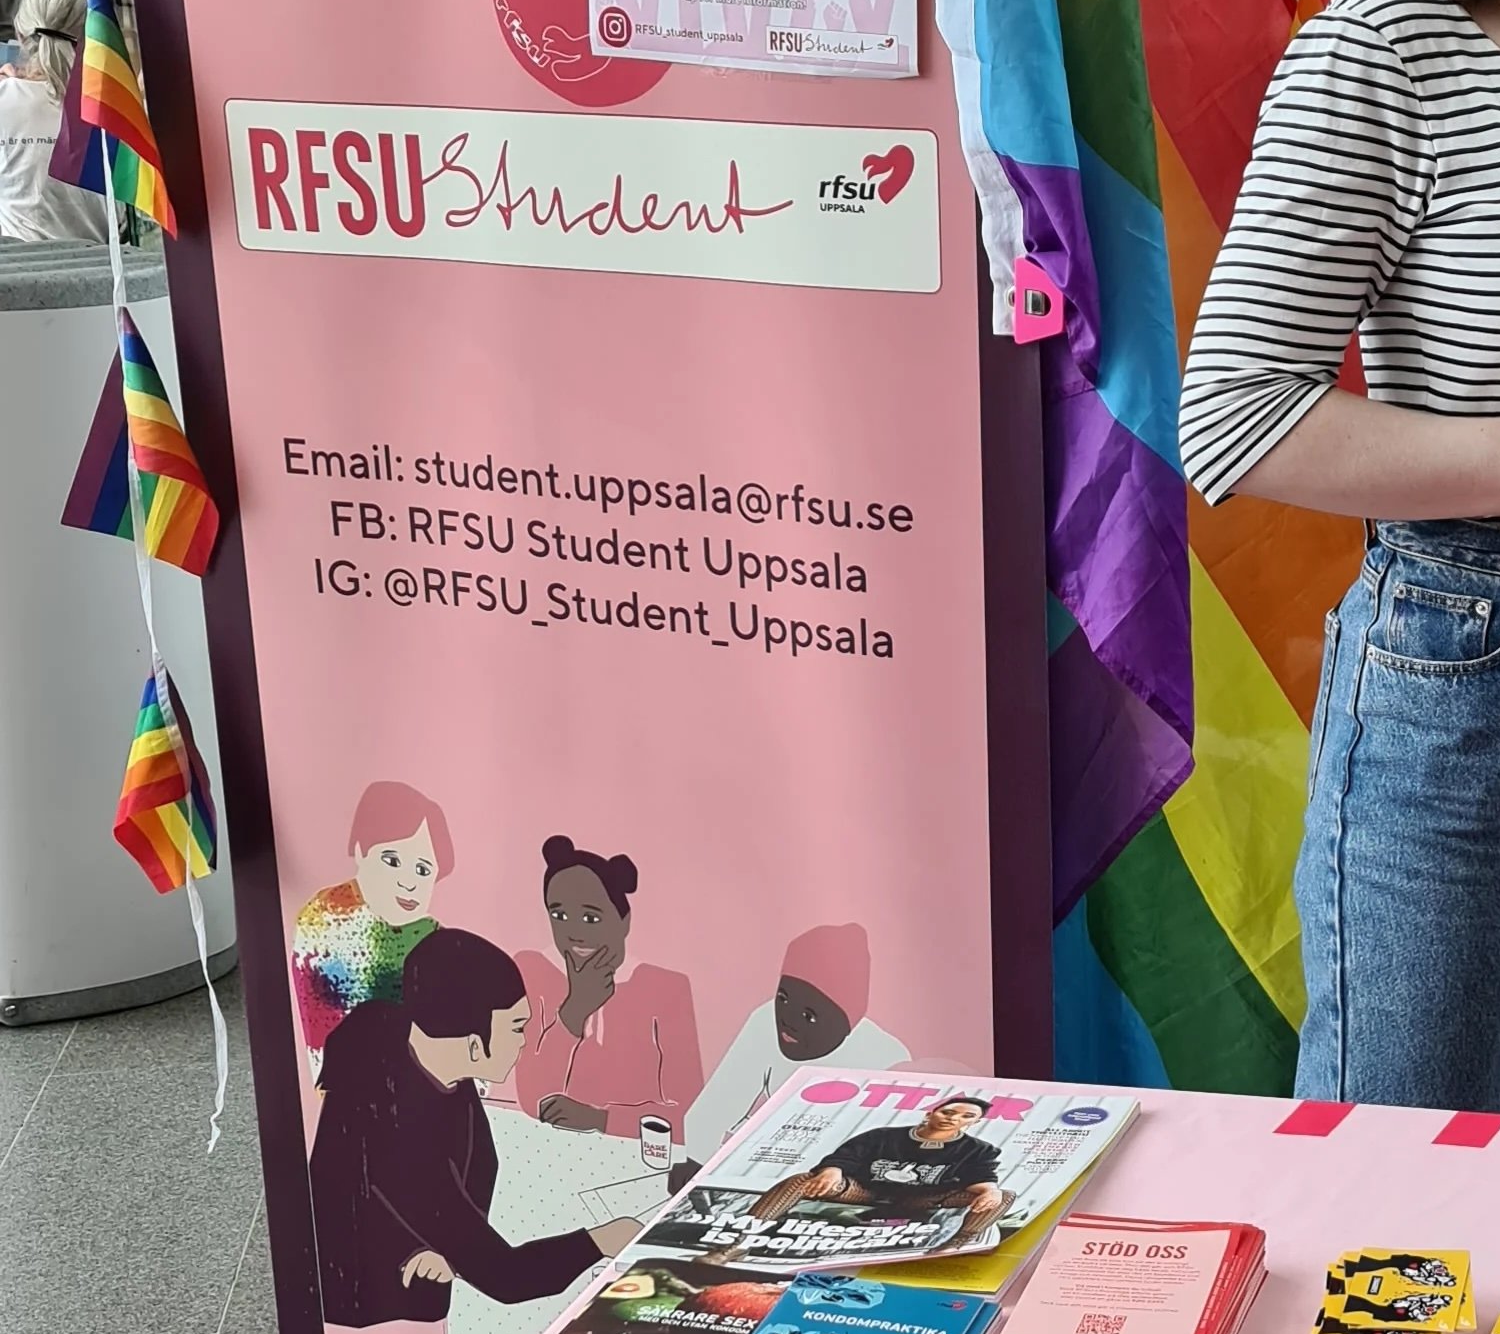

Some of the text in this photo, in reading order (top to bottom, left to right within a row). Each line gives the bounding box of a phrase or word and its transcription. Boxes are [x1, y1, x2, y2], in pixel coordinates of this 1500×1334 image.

[634, 24, 744, 43] RFSU_student_uppsala
[769, 30, 873, 55] RFSU Student
[247, 127, 794, 238] RFSU Student
[817, 172, 877, 203] rfsu
[819, 203, 866, 215] UPPSALA
[282, 438, 914, 533] Email: student.uppsala@rfsu.se
[329, 501, 869, 599] FB: RFSU Student Uppsala
[314, 558, 895, 662] IG: @RFSU_Student_Uppsala
[700, 1226, 741, 1245] is
[777, 1217, 940, 1238] lifestyle
[1081, 1241, 1188, 1259] STÖD OSS
[637, 1305, 759, 1329] SÄKRARE SEX
[682, 1321, 708, 1329] UTAN
[709, 1323, 750, 1334] KONDOM
